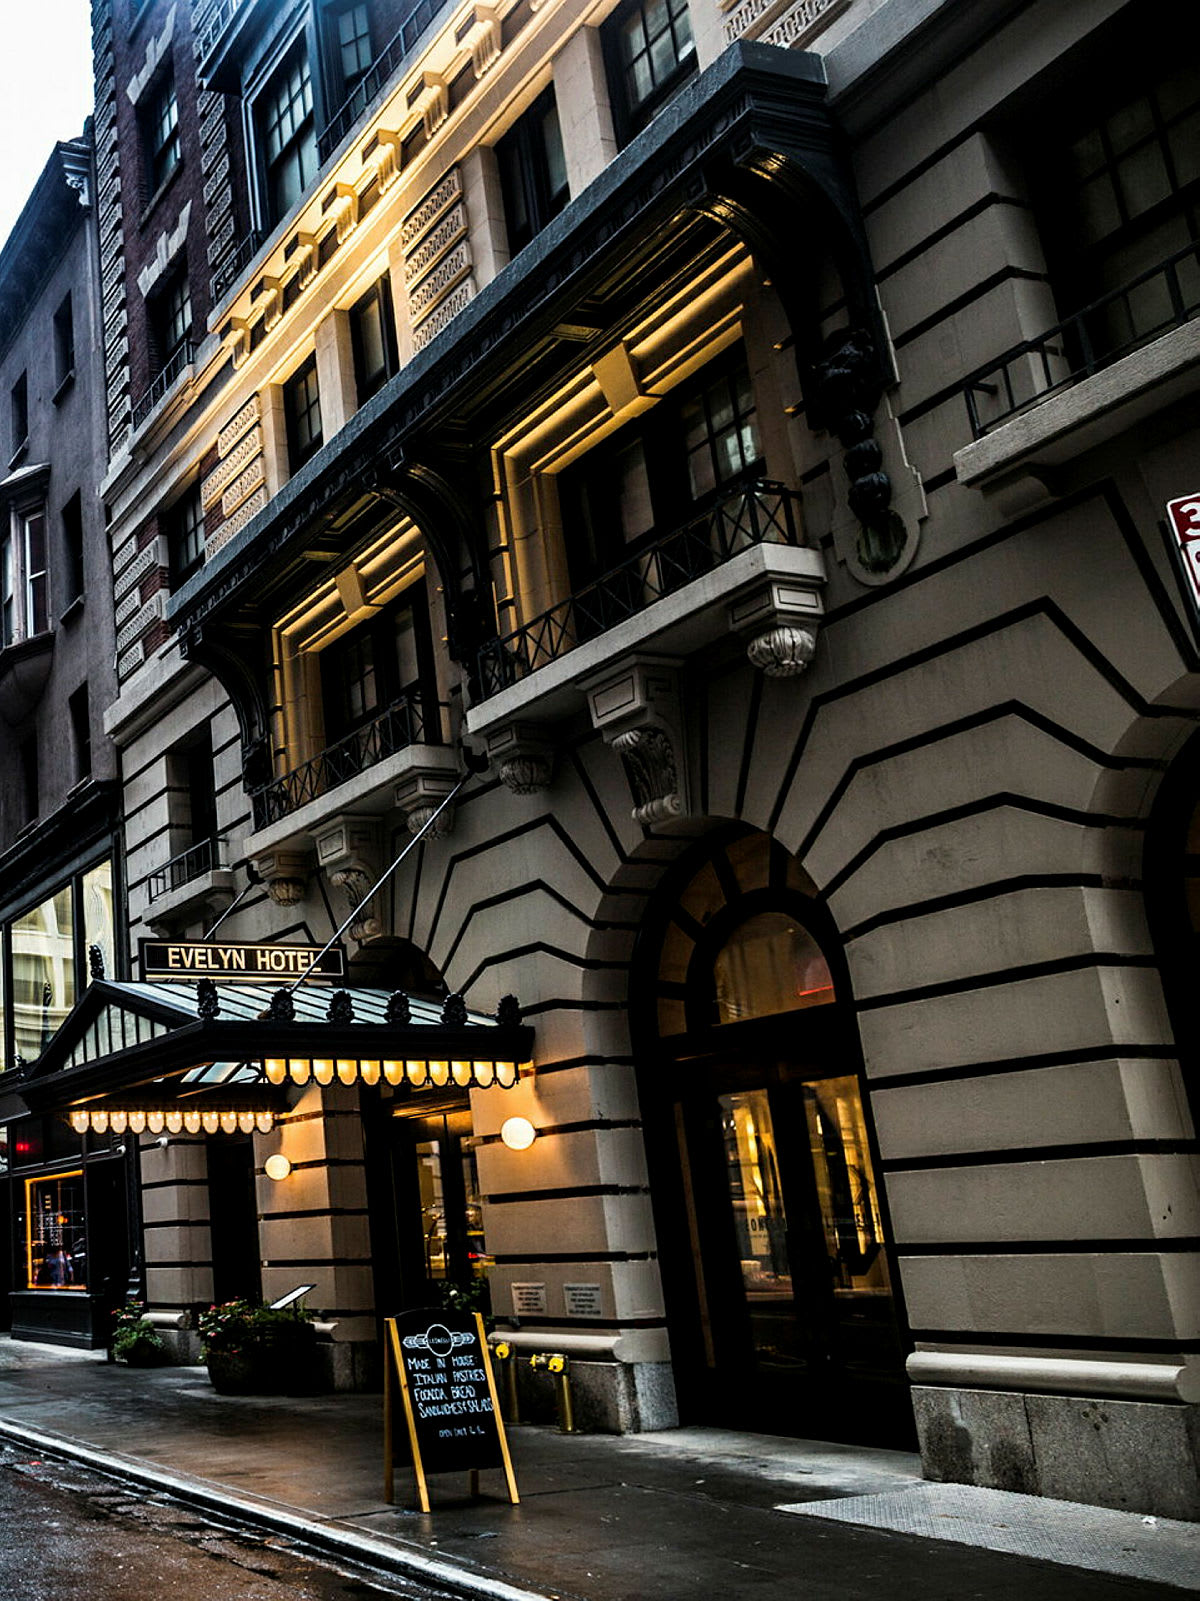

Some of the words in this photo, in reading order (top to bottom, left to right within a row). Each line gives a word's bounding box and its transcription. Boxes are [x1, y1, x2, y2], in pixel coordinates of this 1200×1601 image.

[167, 947, 246, 969] EVELYN
[257, 950, 322, 972] HOTEL
[407, 1357, 431, 1371] MADE
[436, 1358, 446, 1369] IN
[413, 1373, 448, 1386] ITALIAN
[452, 1369, 486, 1383] PASTRIES
[450, 1385, 476, 1399] BREAD
